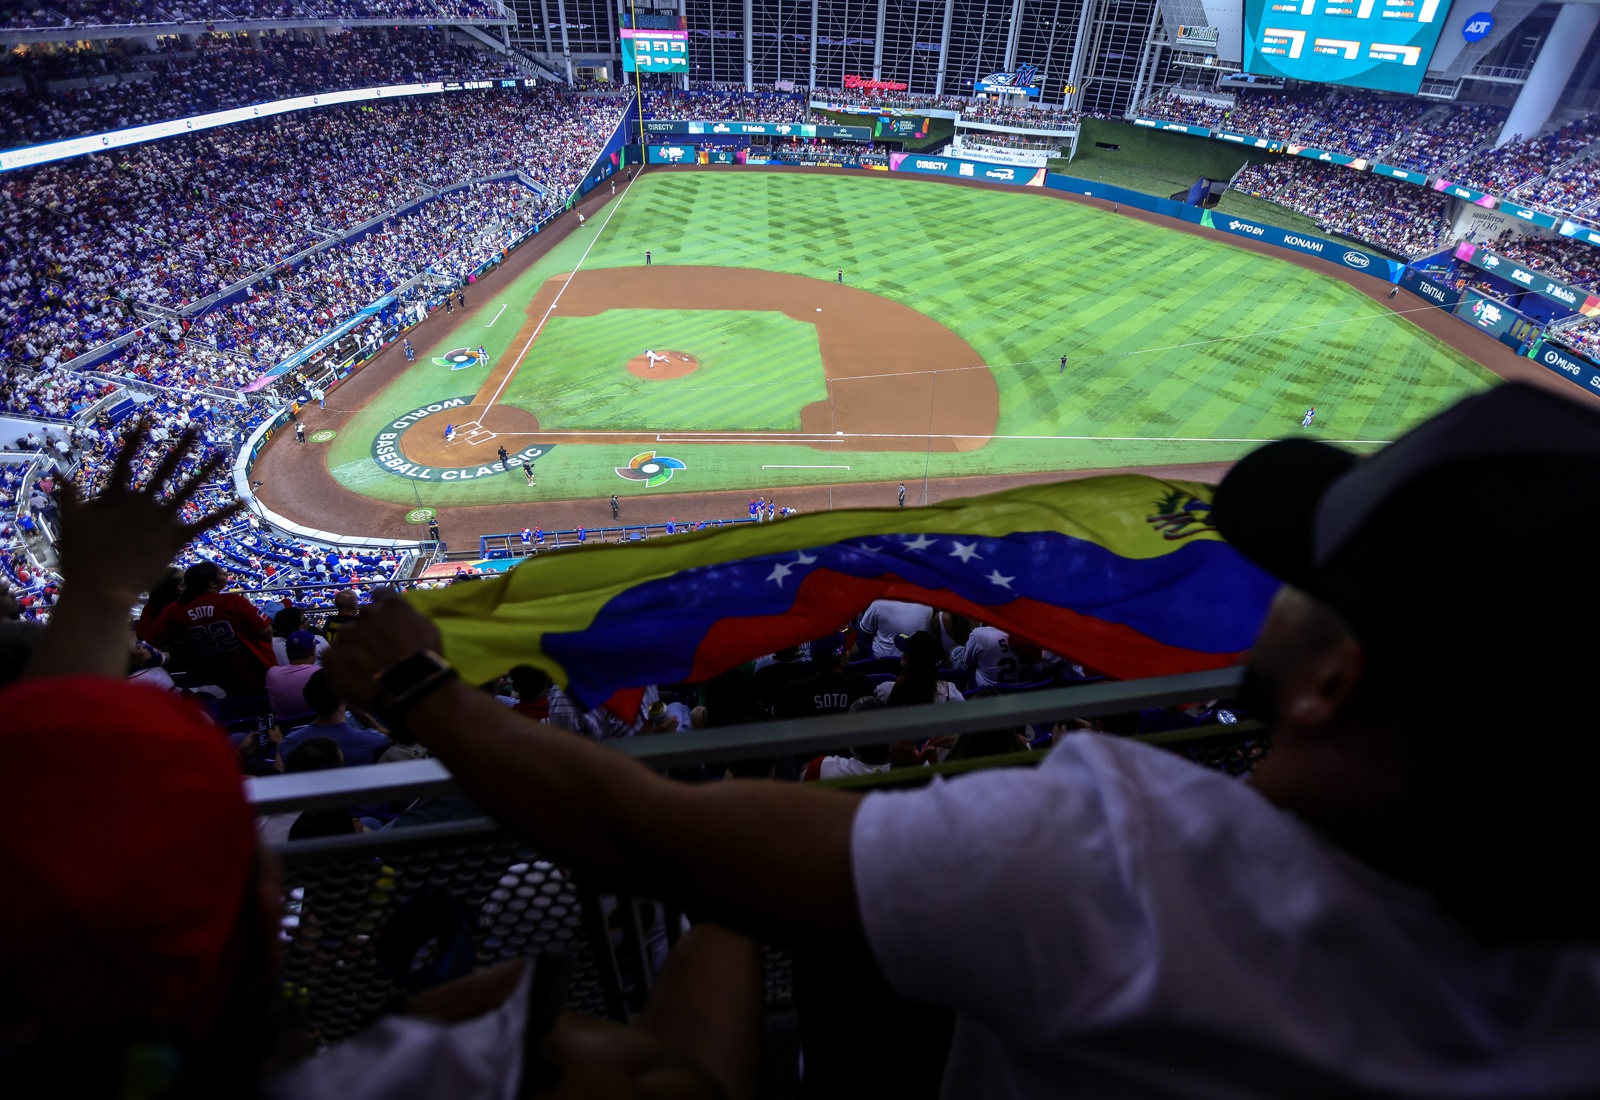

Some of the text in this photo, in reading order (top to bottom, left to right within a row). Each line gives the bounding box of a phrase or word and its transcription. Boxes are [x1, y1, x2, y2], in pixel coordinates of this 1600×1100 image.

[638, 15, 669, 28] 2026
[1465, 21, 1490, 33] ADT
[843, 74, 908, 91] Budweiser
[648, 123, 673, 131] DIRECTV
[916, 159, 948, 171] DIRECTV
[1239, 223, 1265, 236] ITO EN
[1470, 219, 1499, 232] 1796
[1283, 235, 1324, 252] KONAMI
[1345, 252, 1370, 267] Kowa
[1419, 281, 1446, 302] TENTIAL
[1553, 286, 1577, 305] Mobile
[1555, 357, 1581, 376] MUFG
[376, 398, 543, 480] WORLD BASEBALL CLASSIC
[187, 605, 215, 620] SOTO
[186, 619, 242, 656] 22
[813, 693, 848, 709] SOTO
